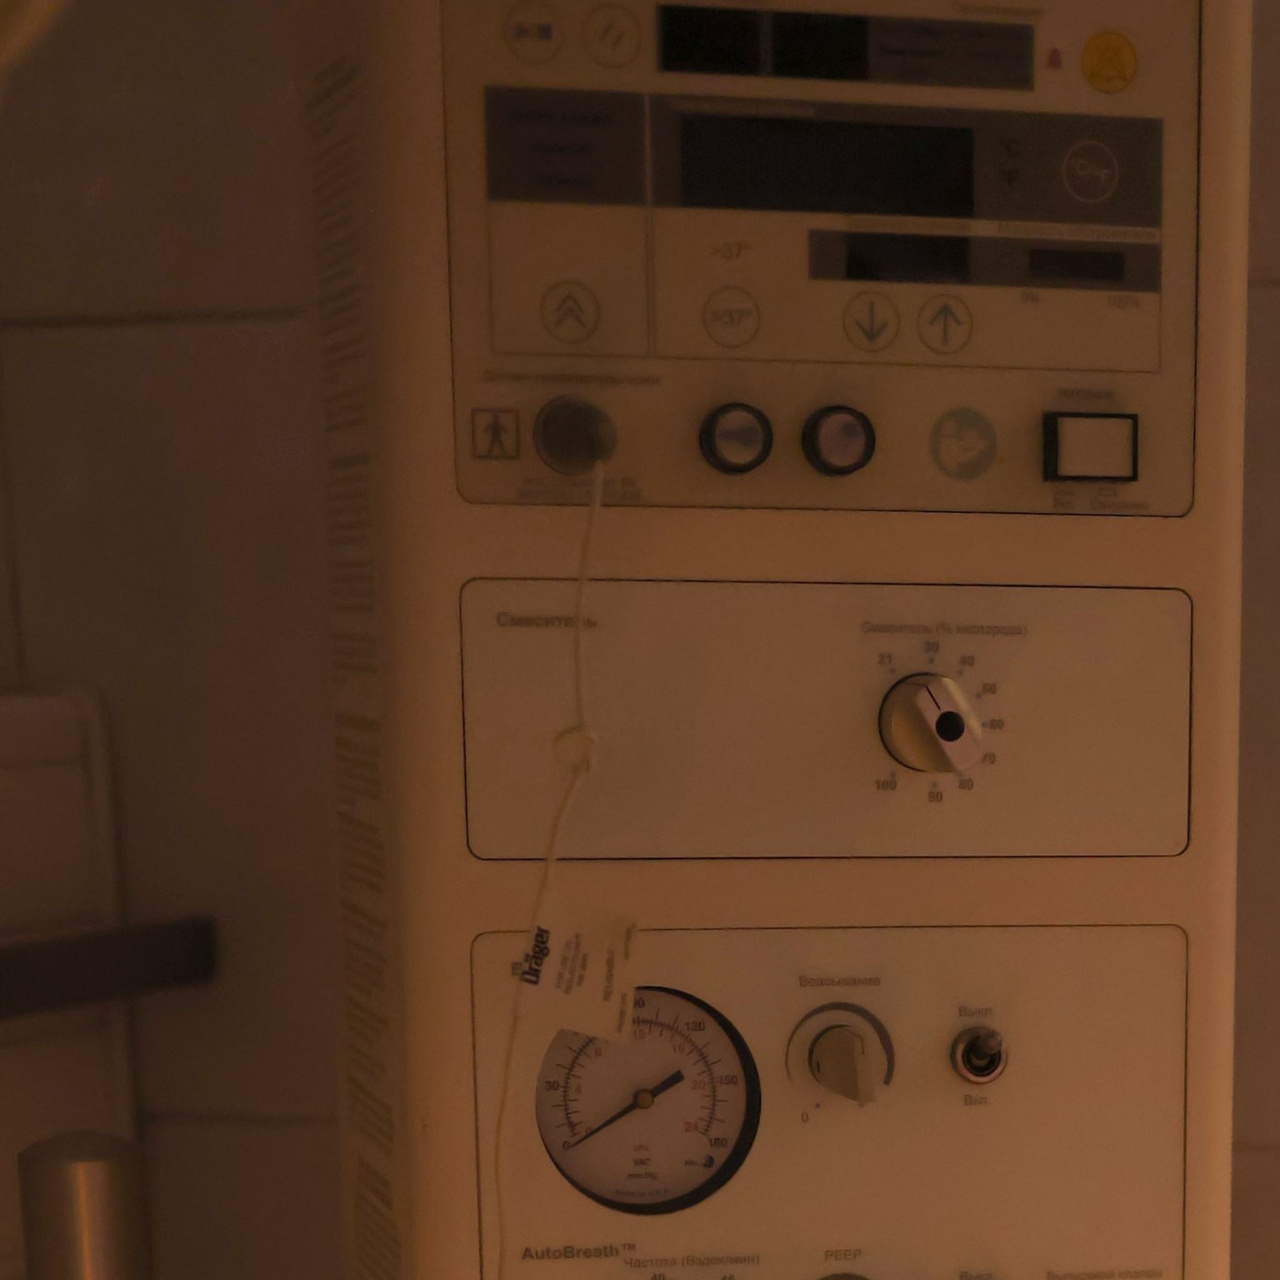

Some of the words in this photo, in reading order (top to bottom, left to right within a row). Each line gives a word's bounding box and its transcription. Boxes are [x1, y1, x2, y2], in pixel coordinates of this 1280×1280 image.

[878, 653, 892, 665] 21
[545, 1080, 560, 1091] 30
[824, 1249, 863, 1262] PEEP
